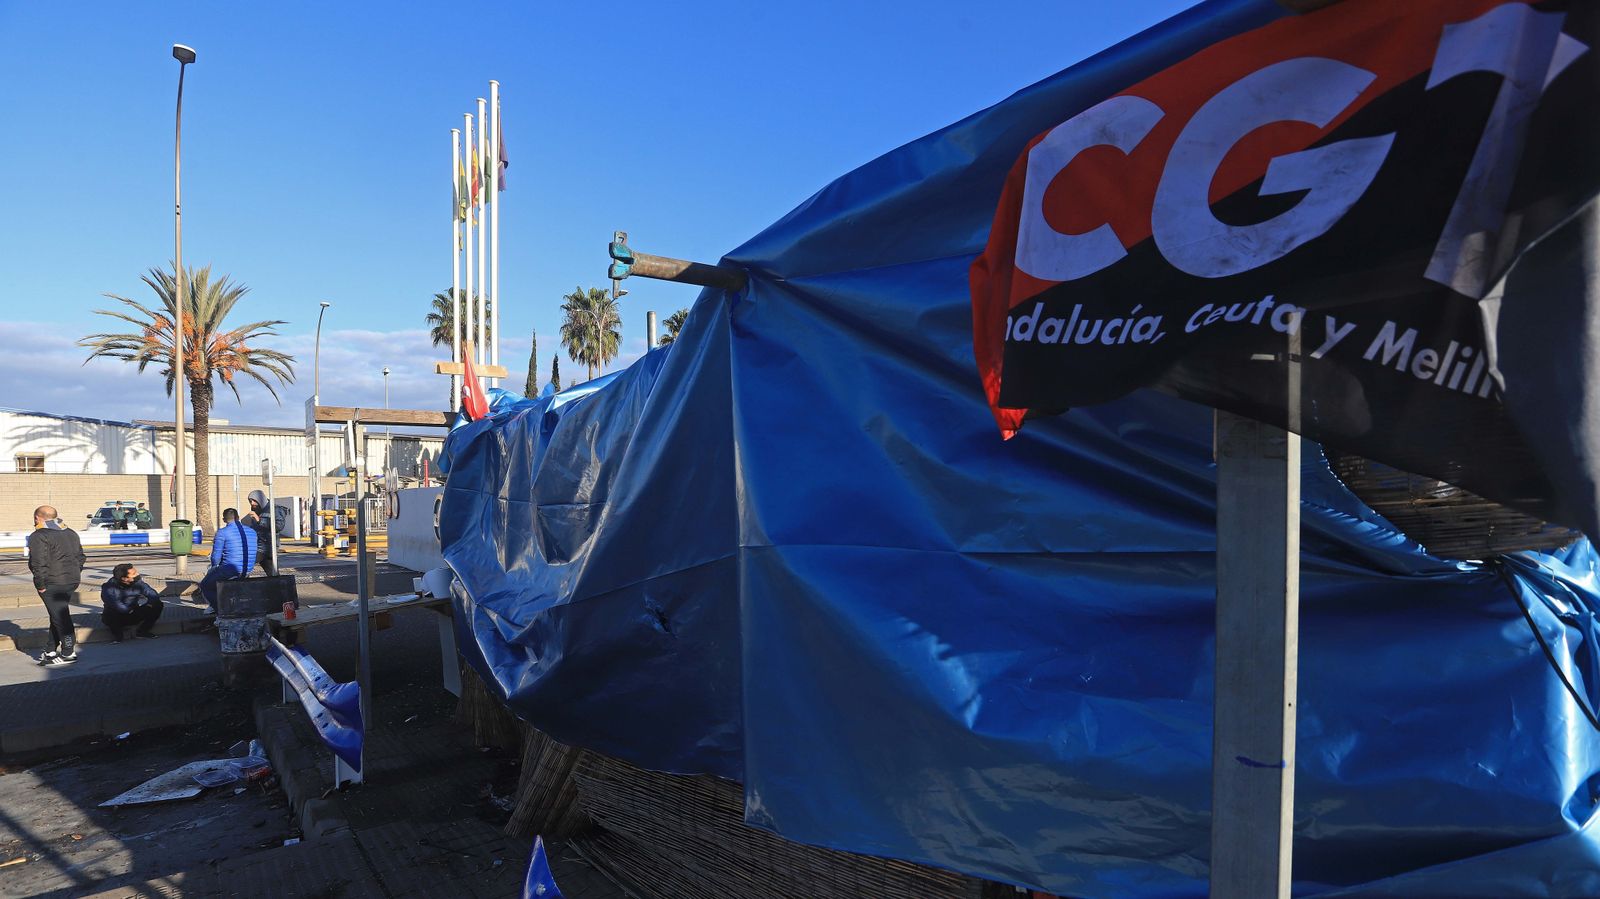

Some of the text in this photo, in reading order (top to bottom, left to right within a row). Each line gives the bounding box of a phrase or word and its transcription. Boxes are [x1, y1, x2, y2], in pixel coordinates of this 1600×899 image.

[1015, 3, 1589, 299] CGT
[1185, 295, 1306, 336] Ceuta
[1310, 315, 1357, 359] y
